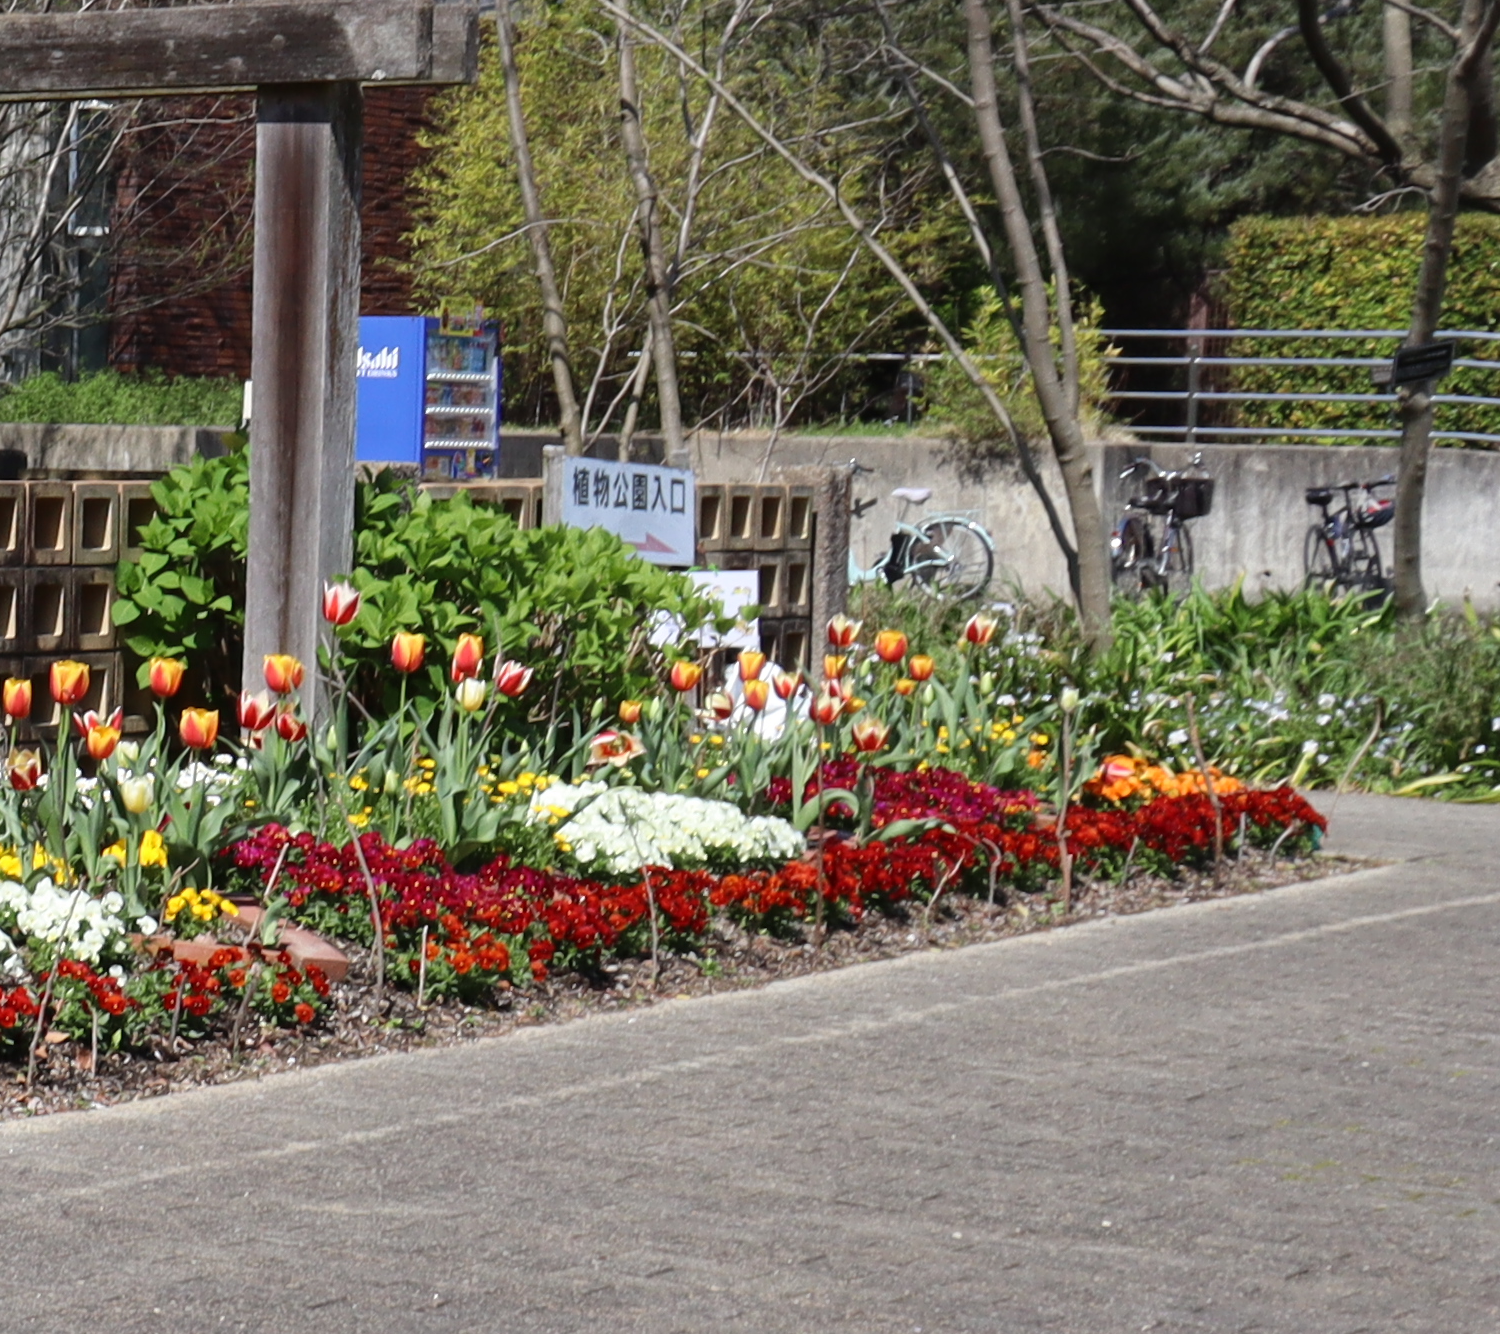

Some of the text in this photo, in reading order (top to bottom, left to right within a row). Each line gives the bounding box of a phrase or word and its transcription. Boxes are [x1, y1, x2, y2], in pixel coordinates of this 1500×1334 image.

[573, 466, 685, 515] 植物公園入口
